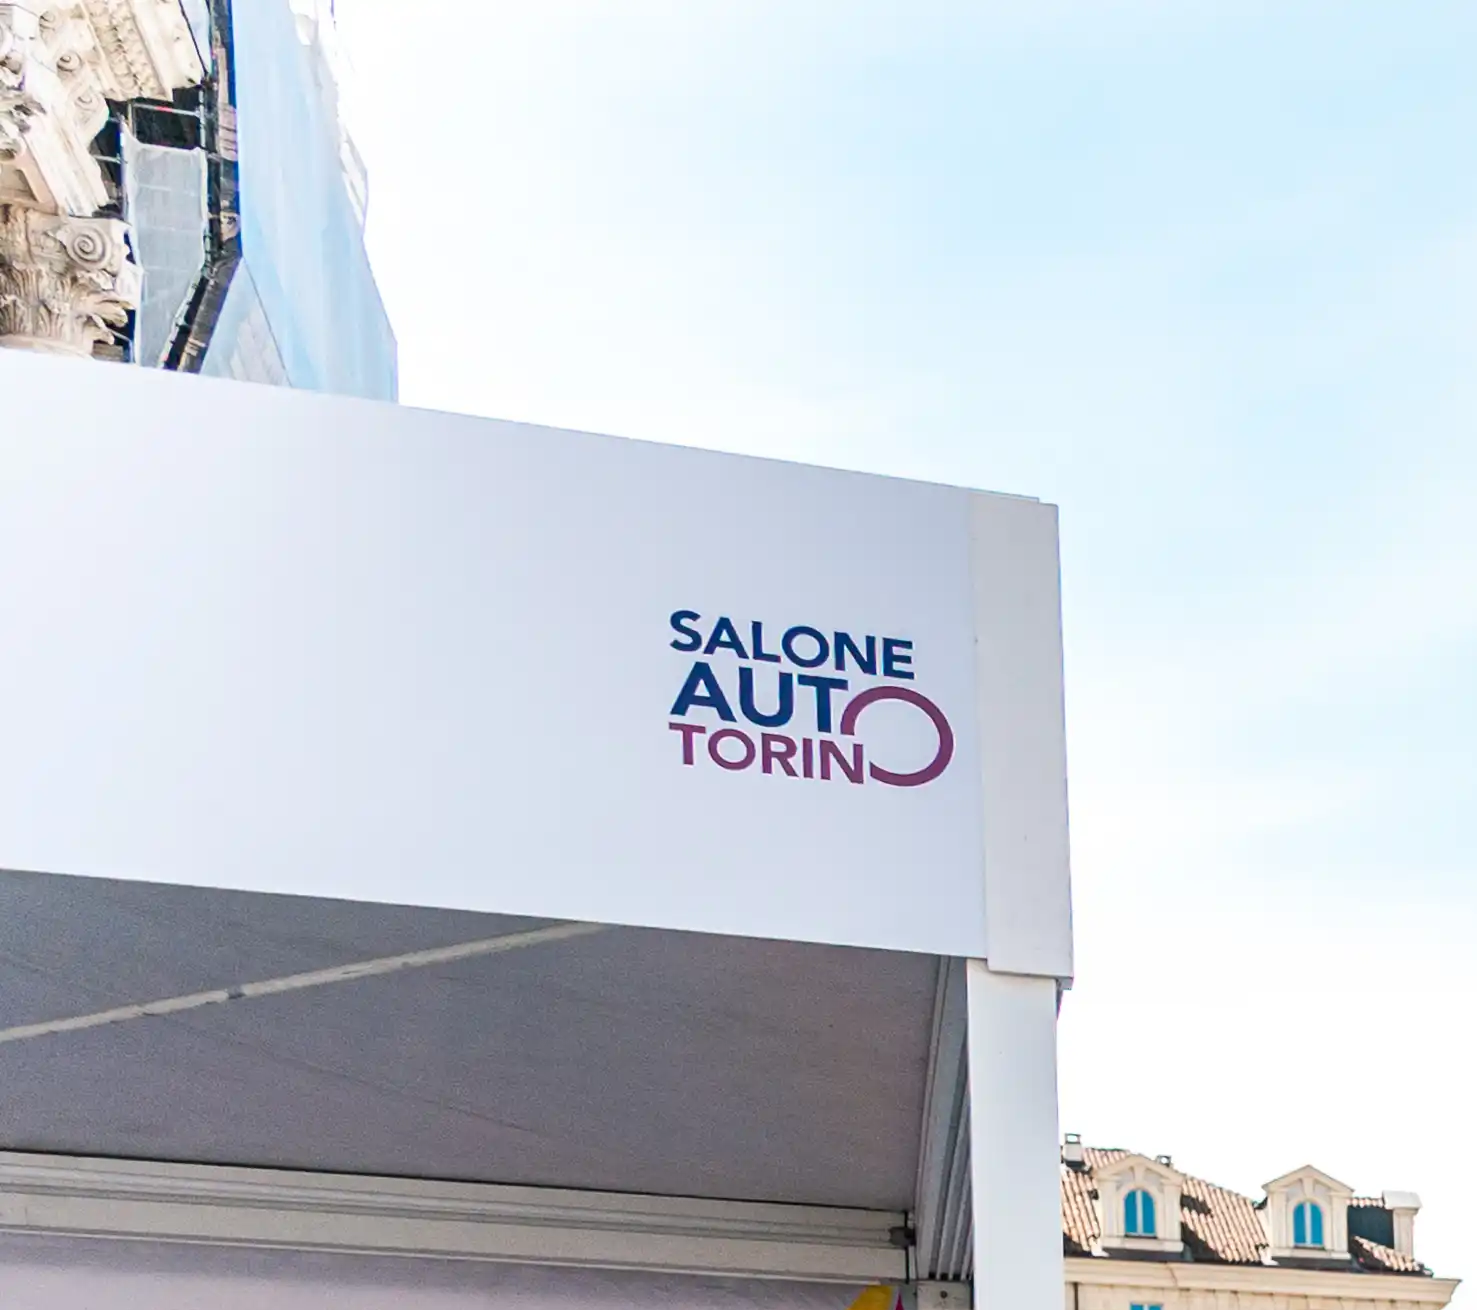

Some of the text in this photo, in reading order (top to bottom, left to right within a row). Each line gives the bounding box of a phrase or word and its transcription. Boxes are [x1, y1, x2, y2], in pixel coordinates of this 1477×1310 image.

[669, 609, 915, 681] SALONE
[668, 721, 954, 787] TORINO
[669, 660, 954, 787] AUTO
